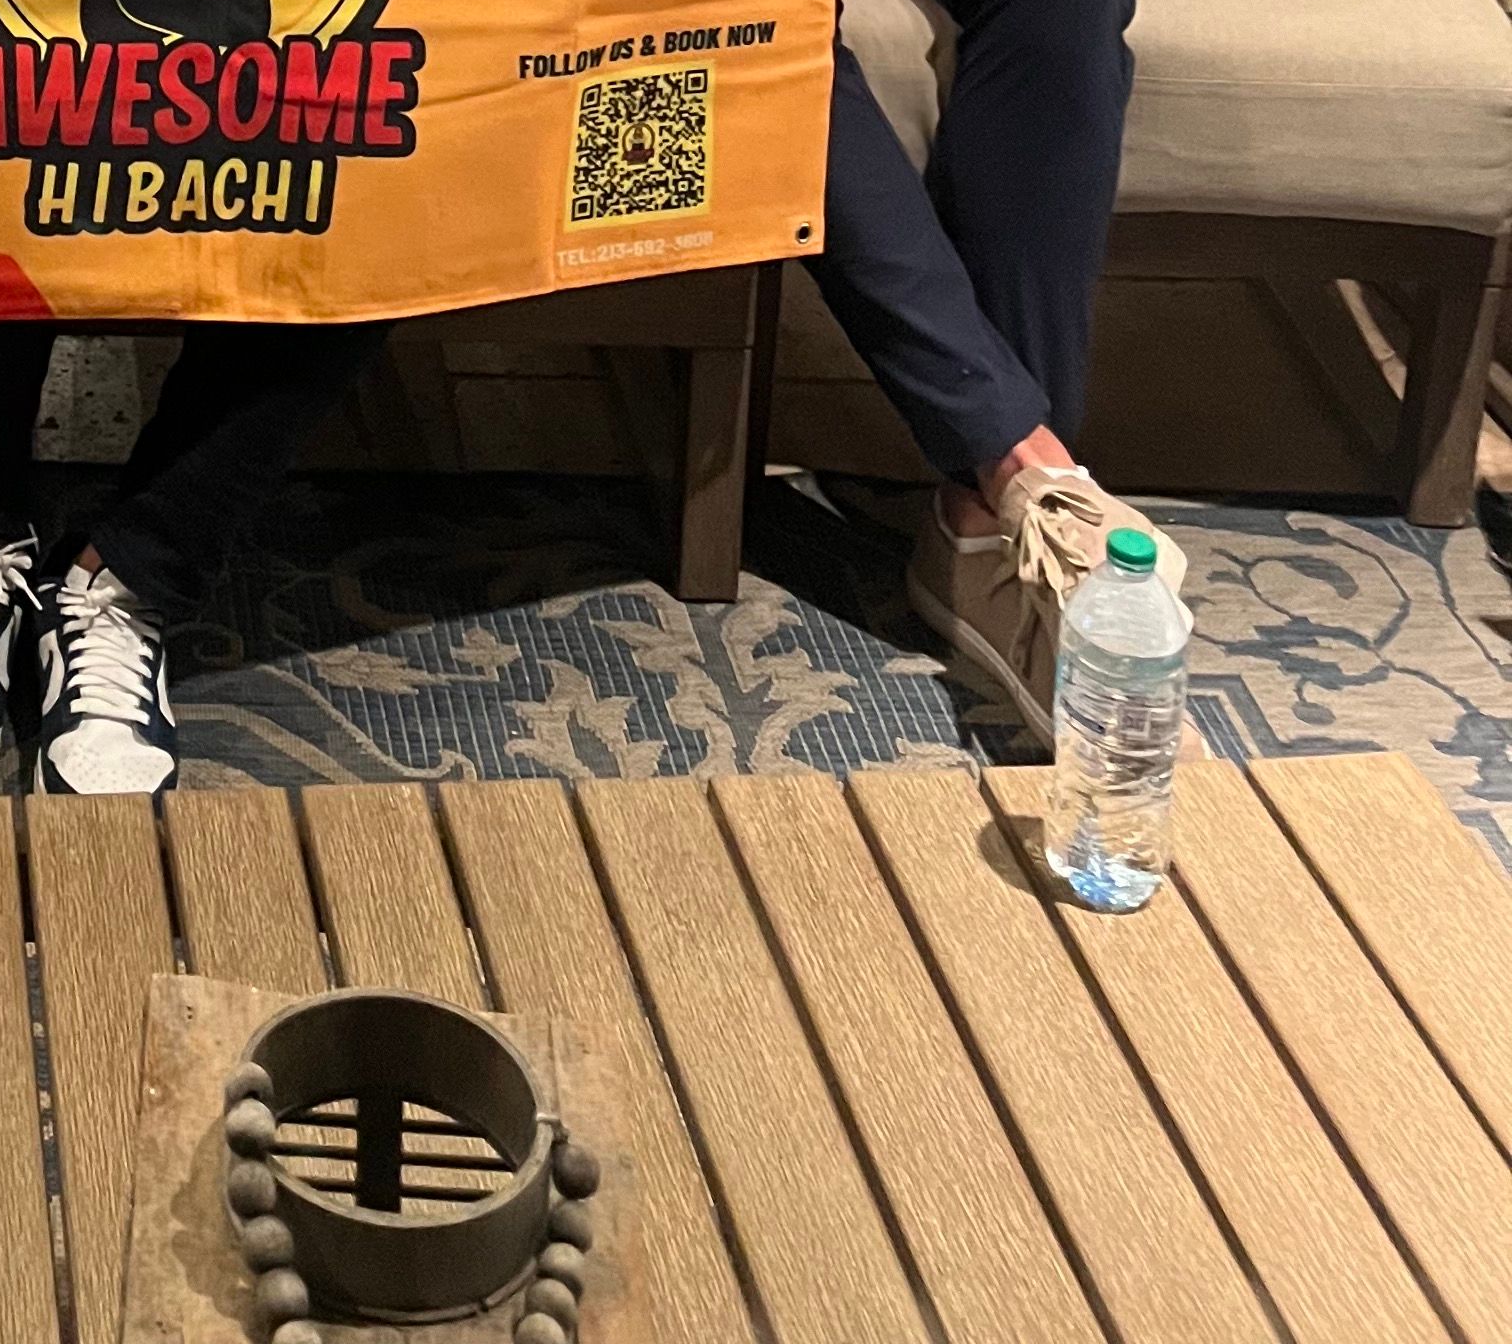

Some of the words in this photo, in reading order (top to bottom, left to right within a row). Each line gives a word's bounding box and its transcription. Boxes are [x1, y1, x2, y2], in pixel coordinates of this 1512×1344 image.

[519, 45, 606, 79] FOLLOW
[609, 37, 635, 62] US
[640, 34, 656, 57] &
[663, 27, 722, 54] BOOK
[727, 21, 777, 48] NOW
[38, 158, 323, 225] HIBACHI
